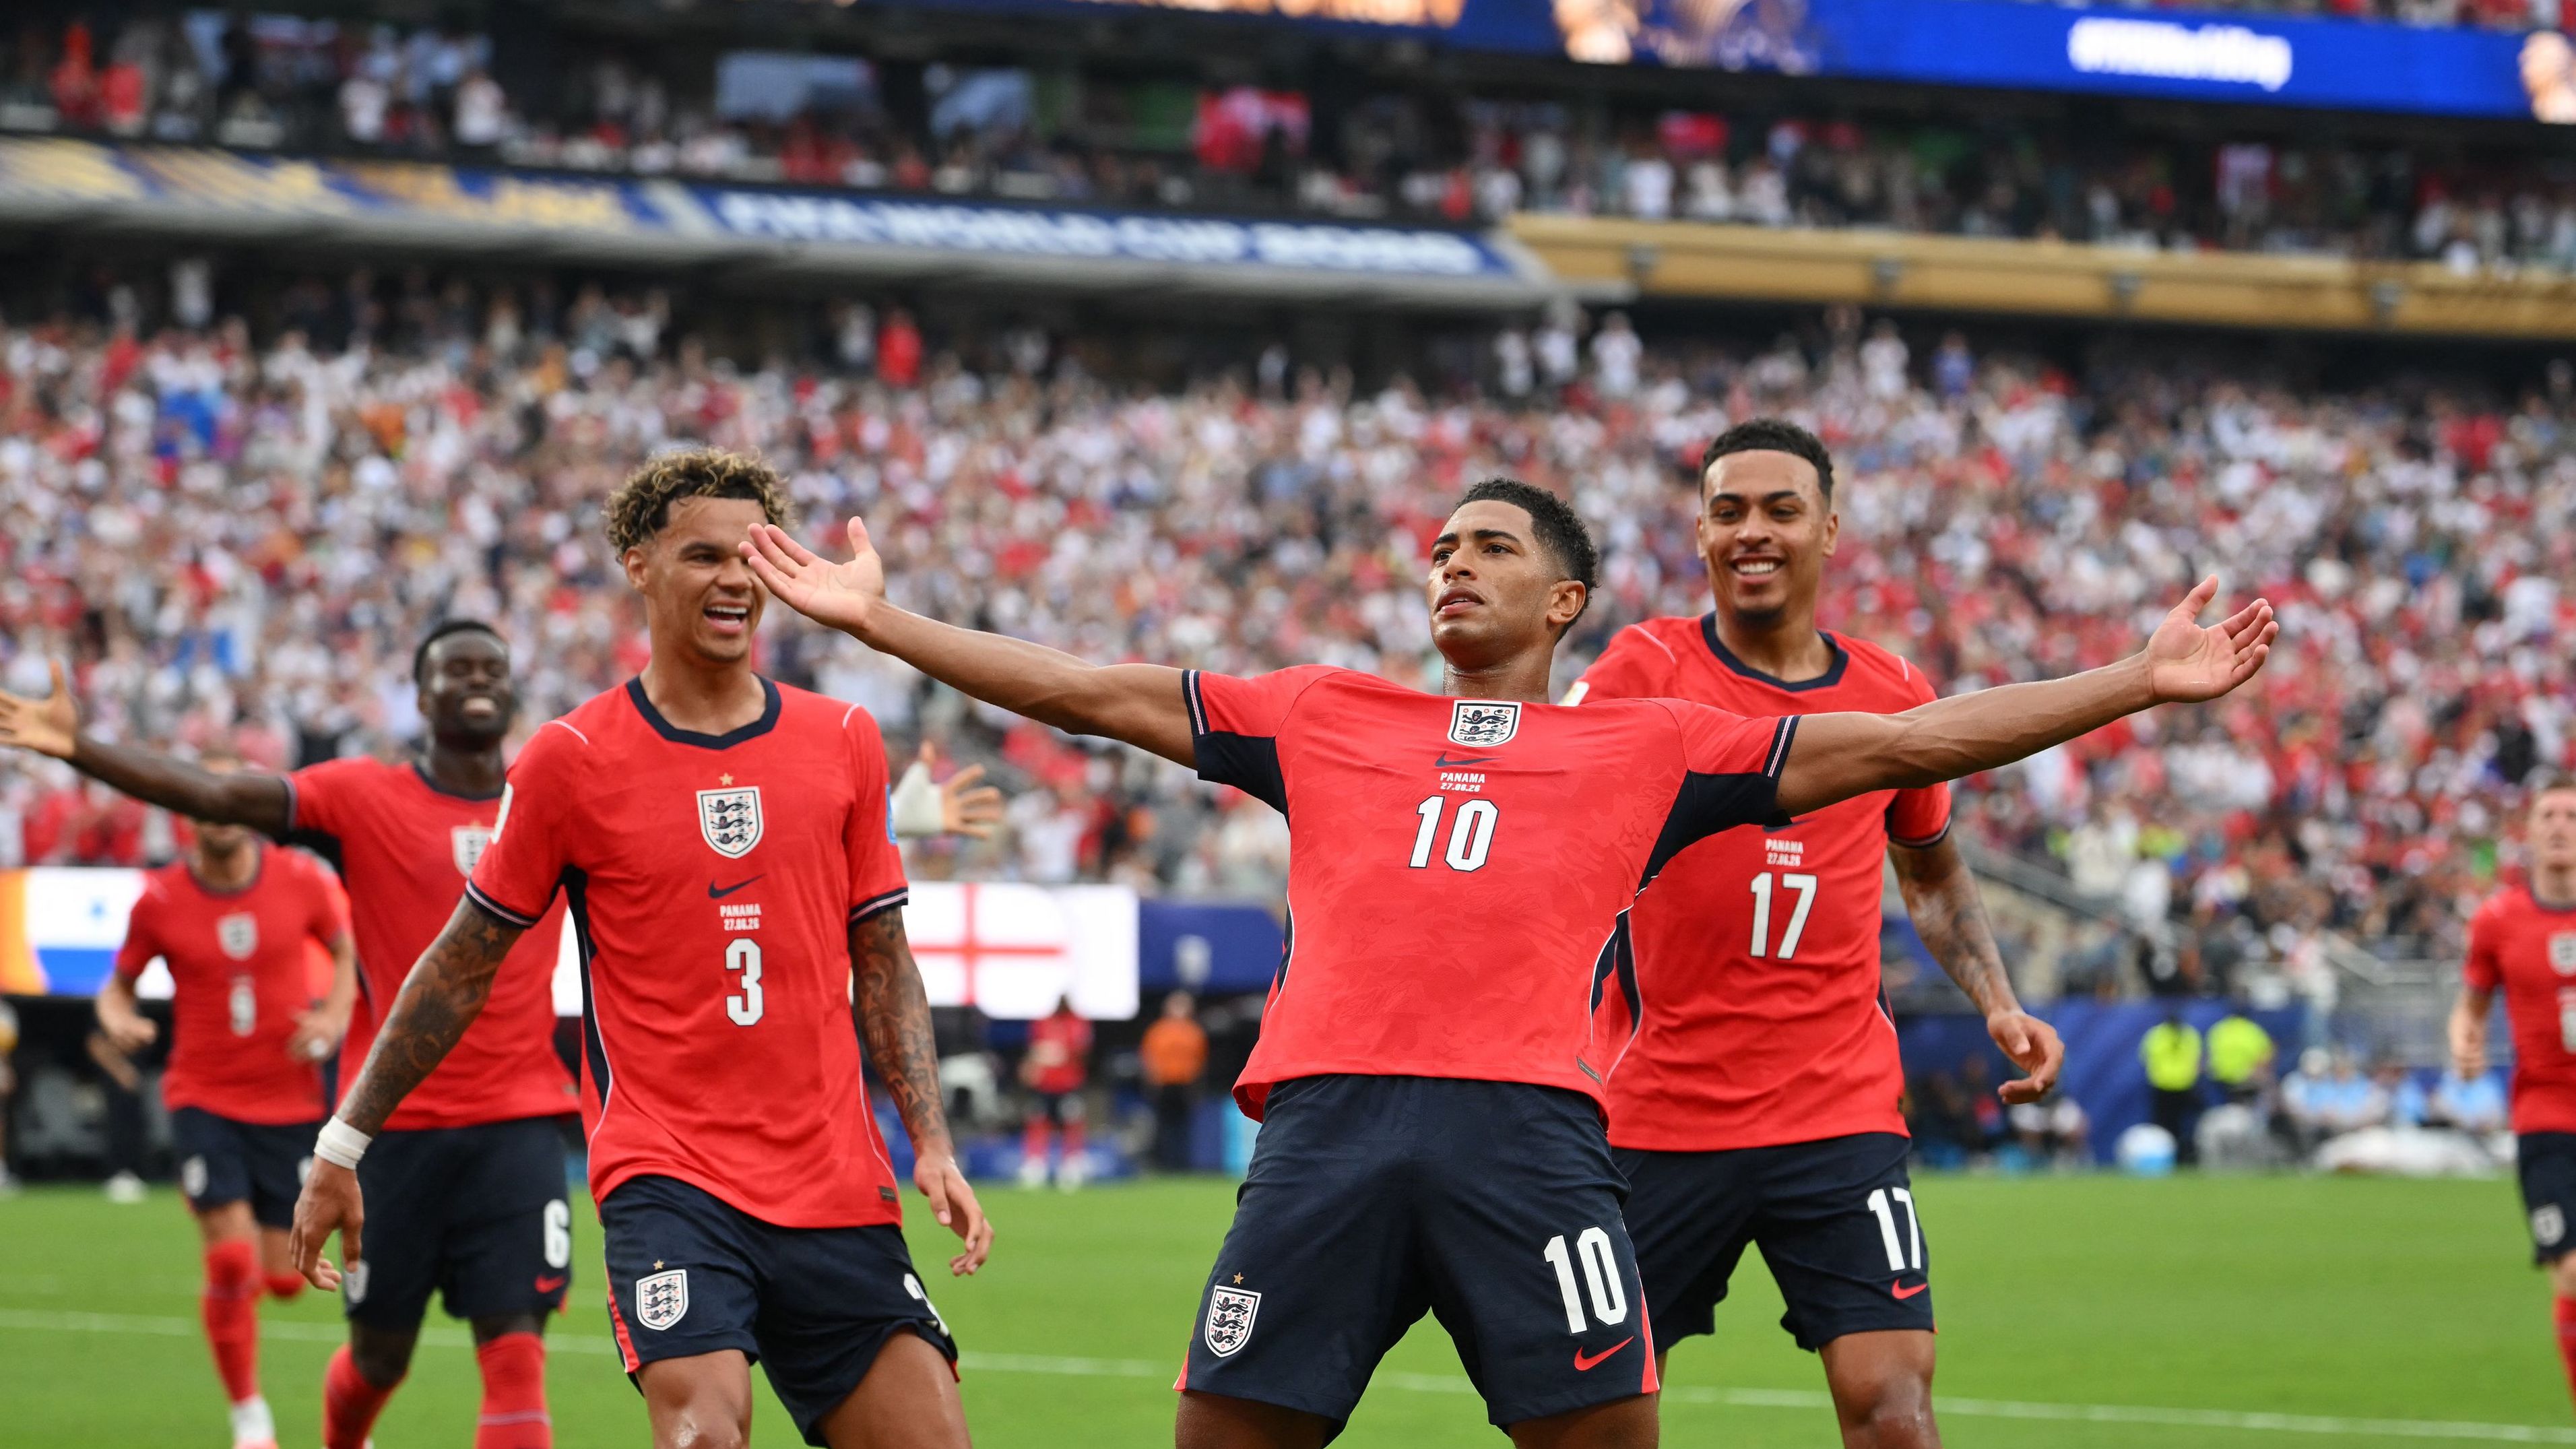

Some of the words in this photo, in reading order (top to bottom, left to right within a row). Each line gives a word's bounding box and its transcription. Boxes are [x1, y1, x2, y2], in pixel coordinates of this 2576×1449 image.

[1440, 772, 1485, 783] PANAMA
[1409, 795, 1500, 872] 10
[1765, 838, 1804, 855] PANAMA
[719, 903, 762, 917] PANAMA
[1750, 872, 1818, 959] 17
[725, 938, 764, 1027] 3
[544, 1198, 570, 1269] 6
[1867, 1186, 1921, 1271] 17
[1542, 1225, 1628, 1336] 10
